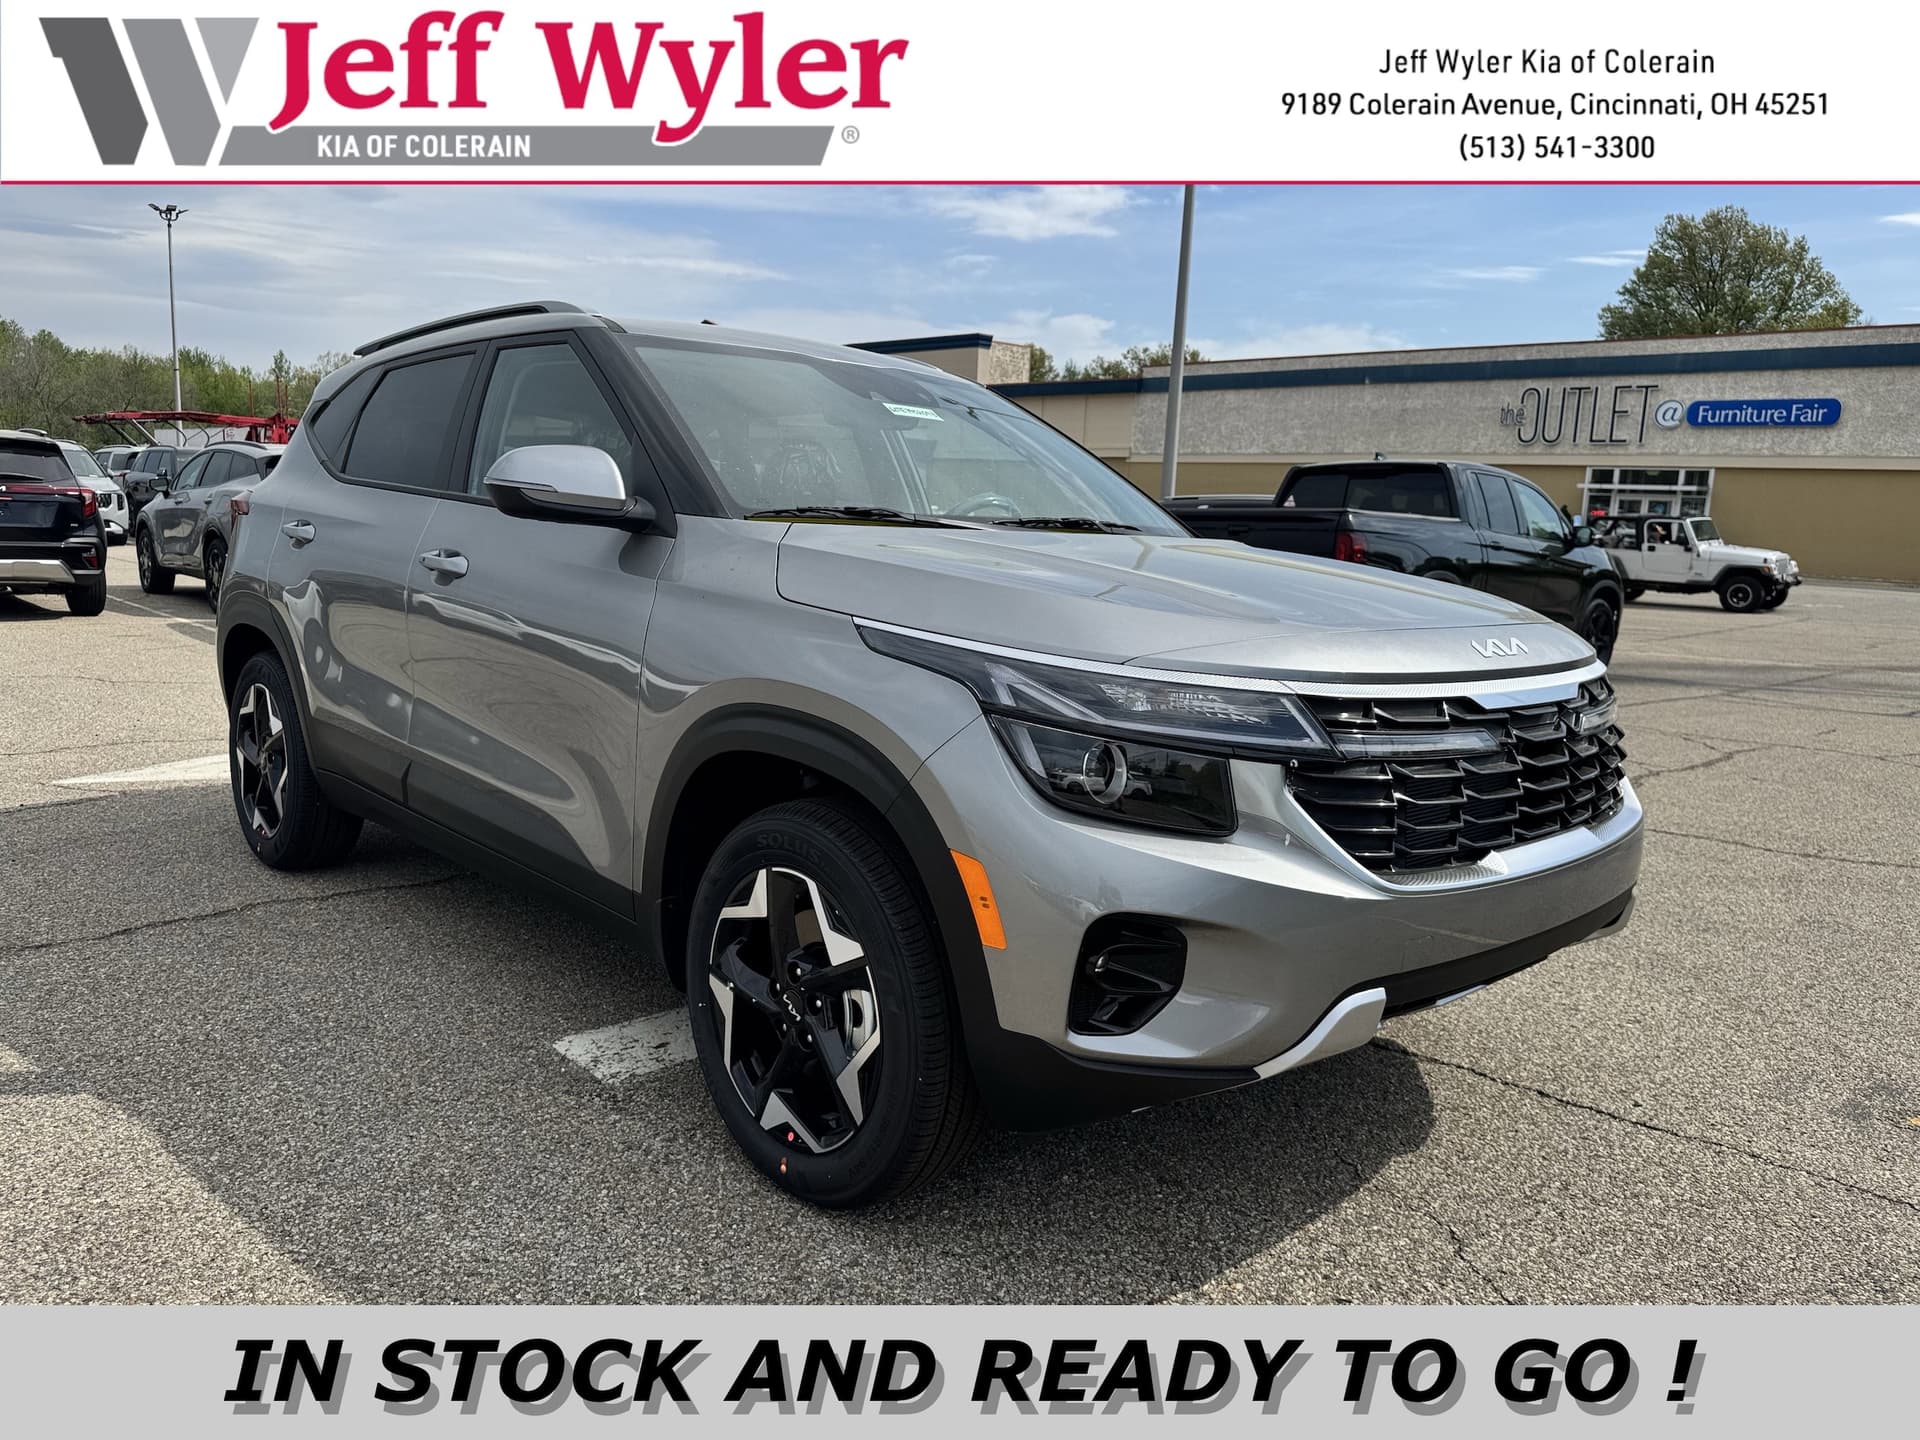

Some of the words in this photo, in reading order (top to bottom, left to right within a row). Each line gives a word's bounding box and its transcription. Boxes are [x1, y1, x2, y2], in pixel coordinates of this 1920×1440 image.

[1500, 402, 1526, 425] the
[1518, 384, 1659, 443] OUTLET
[1697, 404, 1787, 424] Furniture
[1790, 403, 1828, 423] Fair
